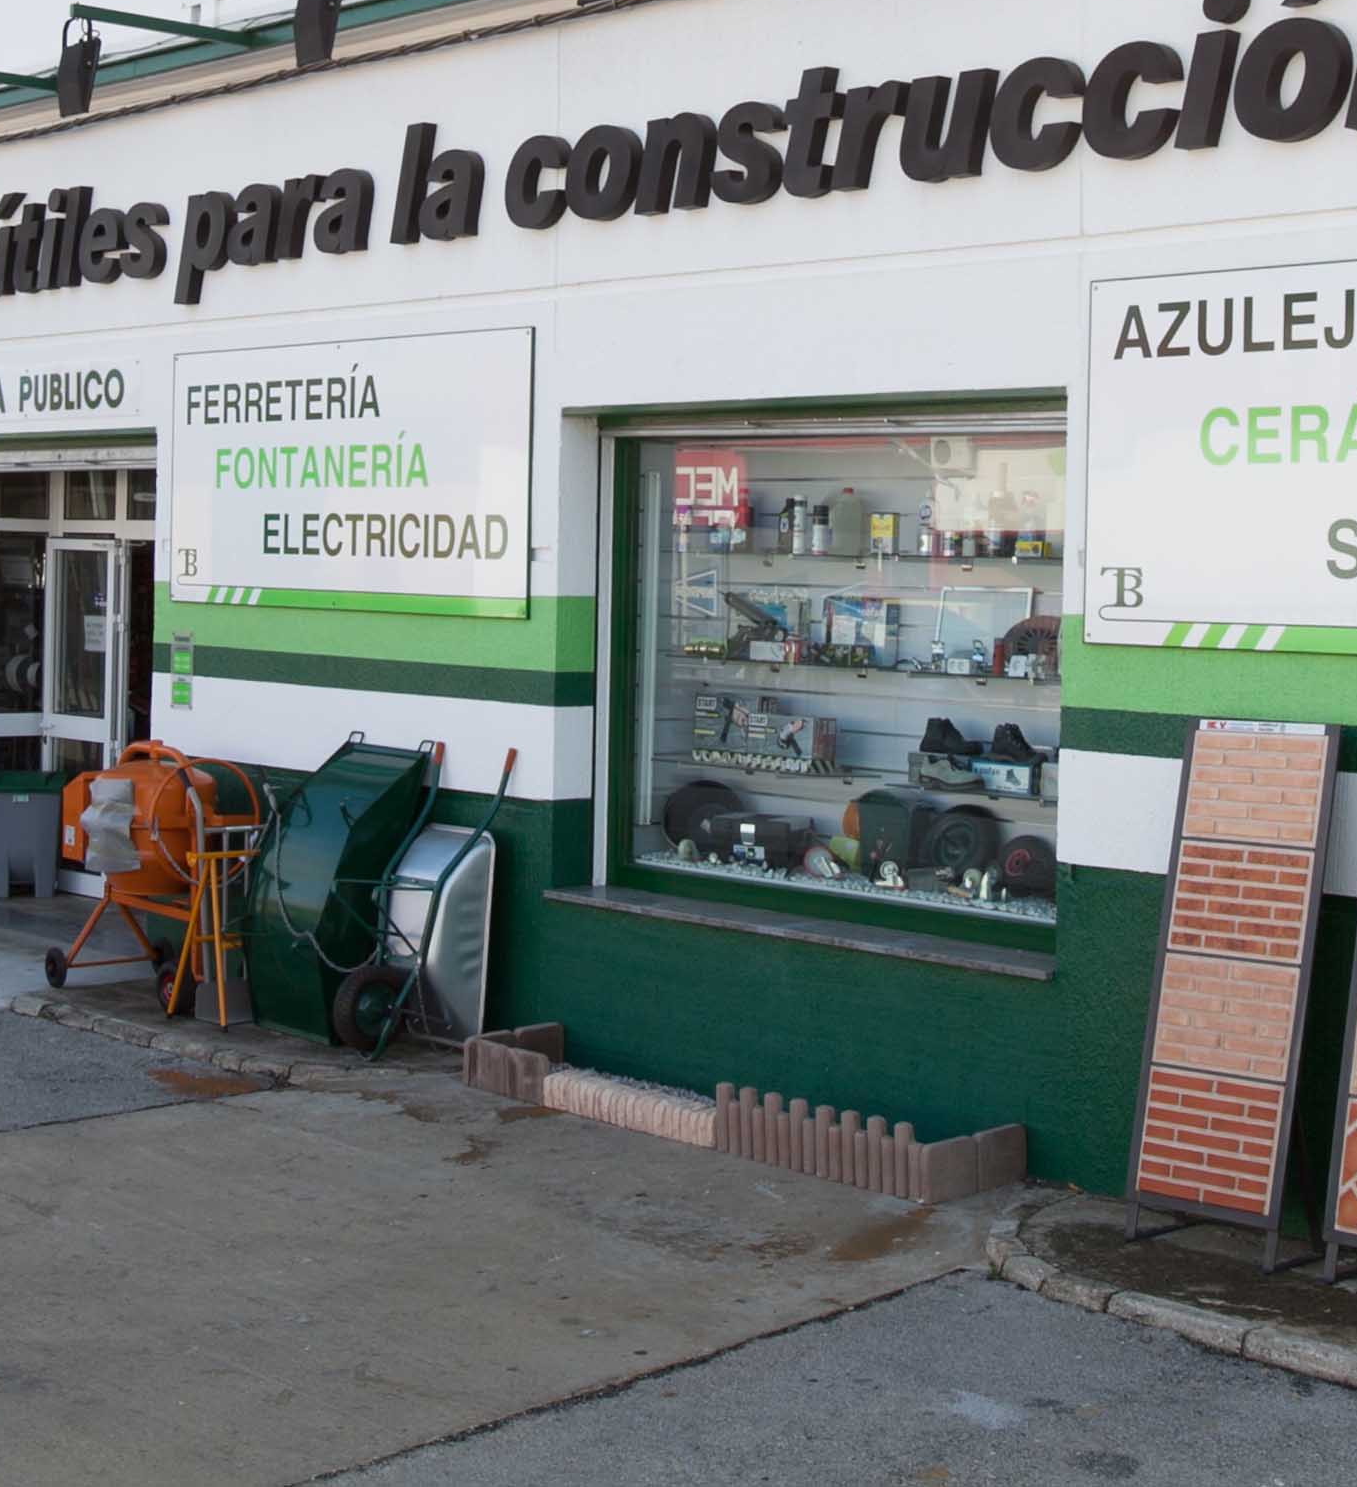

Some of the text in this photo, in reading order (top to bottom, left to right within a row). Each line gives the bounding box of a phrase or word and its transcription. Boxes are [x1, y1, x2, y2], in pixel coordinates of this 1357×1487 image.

[174, 168, 374, 305] para
[390, 121, 484, 246] la
[18, 368, 125, 413] PUBLICO
[186, 362, 381, 425] FERRETERÍA
[215, 430, 429, 490] FONTANERÍA
[262, 513, 509, 560] ELECTRICIDAD
